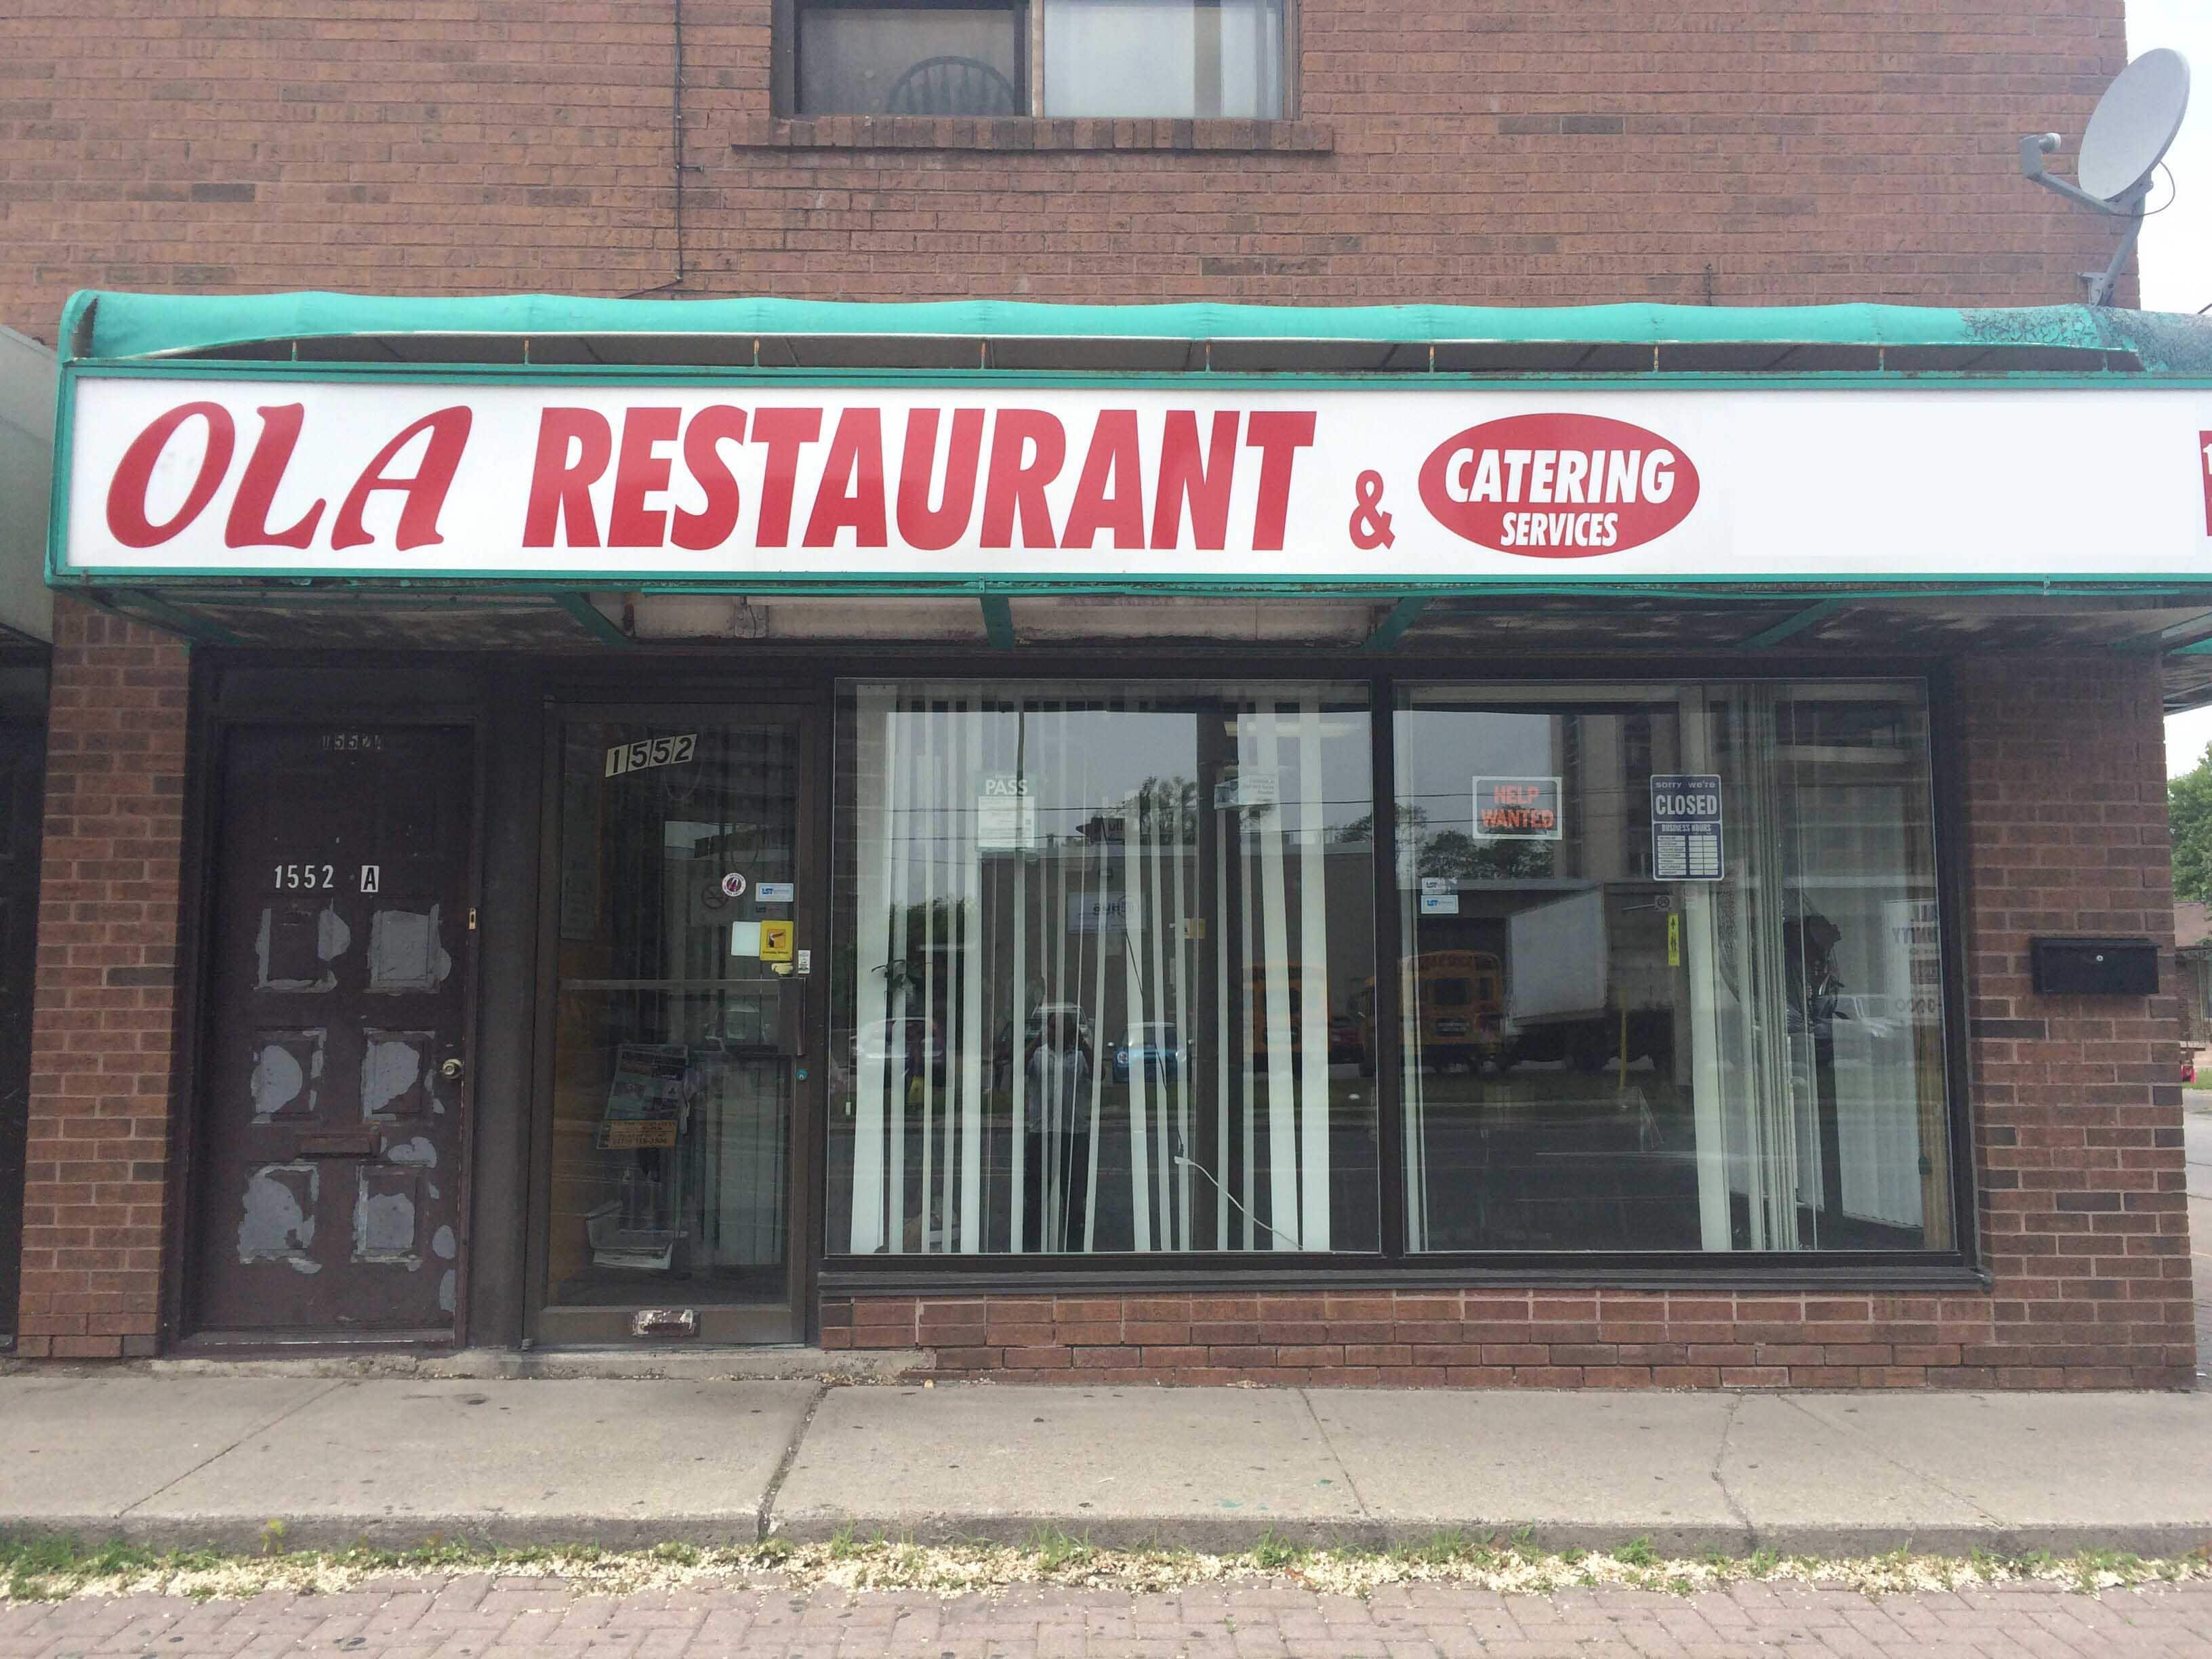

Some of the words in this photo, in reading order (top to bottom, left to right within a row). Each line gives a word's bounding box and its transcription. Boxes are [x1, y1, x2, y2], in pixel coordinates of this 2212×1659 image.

[106, 401, 473, 551] OLA
[522, 405, 1317, 551] RESTAURANT
[1349, 469, 1396, 550] &
[1444, 448, 1676, 504] CATERING
[1500, 512, 1618, 547] SERVICES
[609, 736, 693, 775] 1552
[985, 779, 1029, 796] PASS
[1494, 785, 1540, 804] HELP
[1688, 780, 1716, 788] we're
[1655, 794, 1717, 815] CLOSED
[1481, 808, 1555, 829] WANTED
[274, 864, 334, 889] 1552
[363, 866, 377, 891] A
